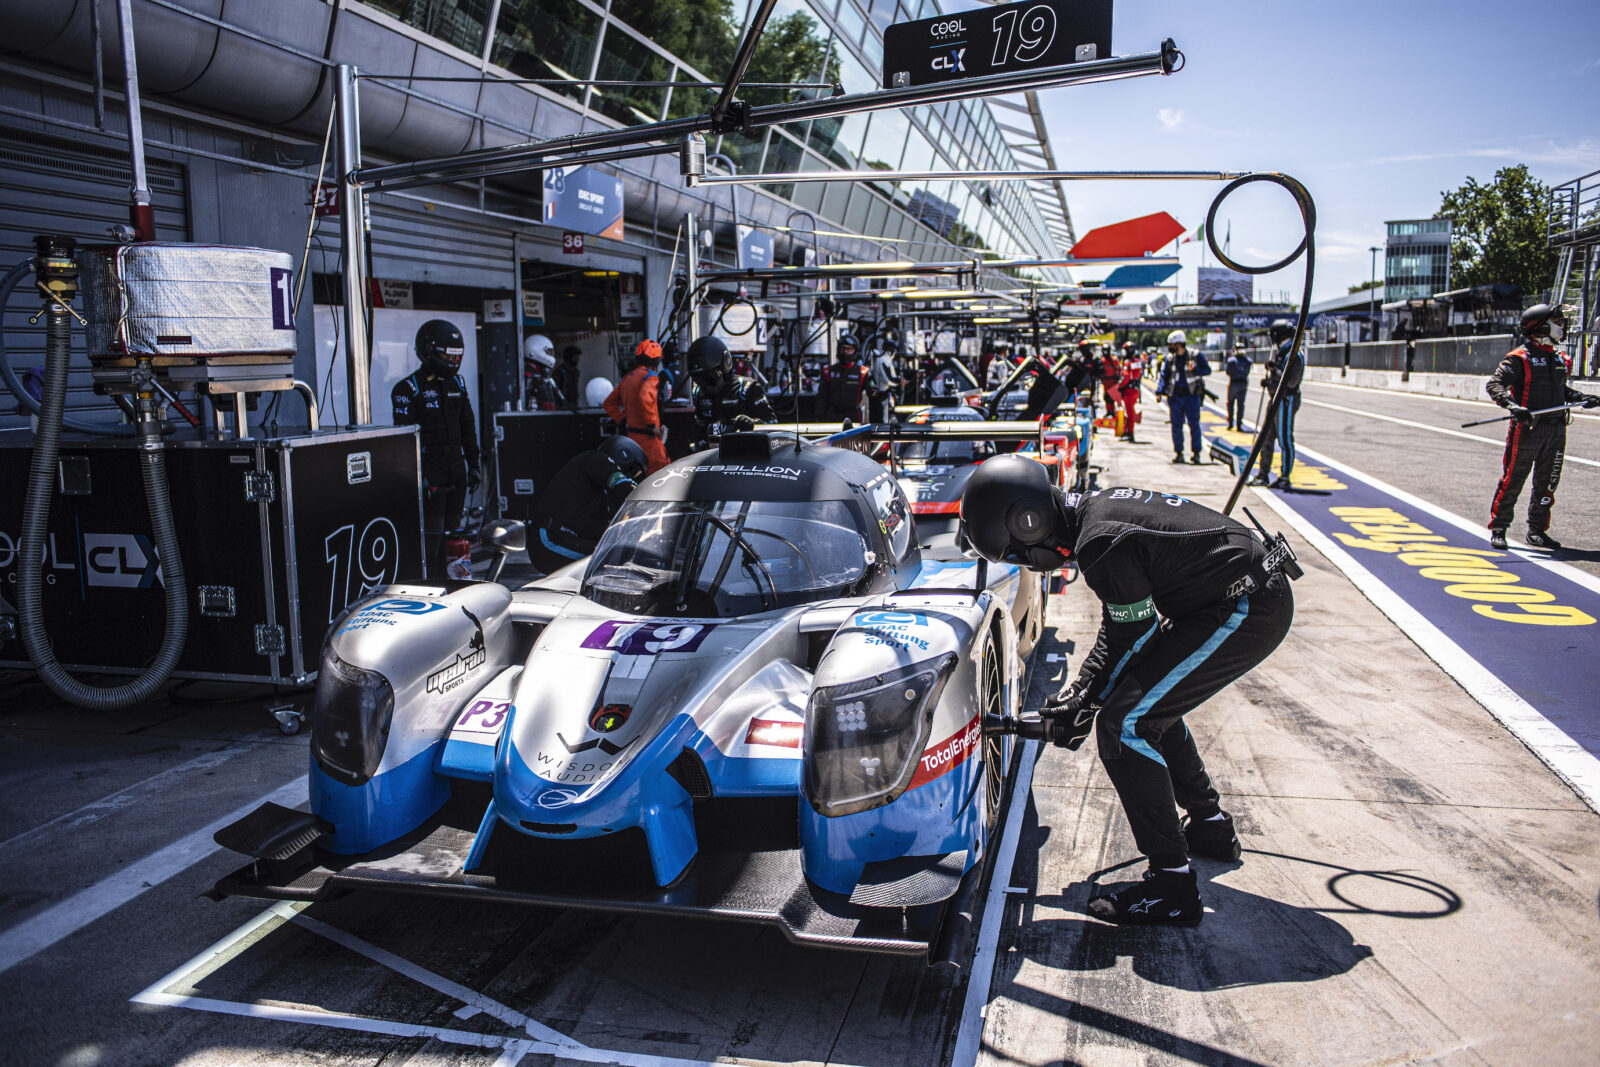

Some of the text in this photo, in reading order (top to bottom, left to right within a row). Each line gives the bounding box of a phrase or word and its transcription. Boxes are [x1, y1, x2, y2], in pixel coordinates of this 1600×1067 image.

[931, 19, 967, 36] COOL
[991, 5, 1057, 66] 19
[931, 48, 966, 73] CLX
[313, 186, 338, 207] 37
[563, 234, 583, 248] 36
[277, 272, 293, 327] 1
[681, 465, 801, 477] REBELLION
[723, 471, 798, 481] TIMEPIECES
[1550, 450, 1564, 483] SPORT
[325, 517, 399, 624] 19
[1328, 506, 1597, 626] GOODYEAR
[343, 617, 399, 626] Stiftung
[1137, 608, 1151, 618] PIT
[606, 623, 704, 653] 19
[865, 624, 909, 632] ADAC
[864, 630, 931, 651] Stiftung
[864, 637, 910, 653] Sport
[445, 678, 464, 692] SPORTS
[458, 700, 511, 728] P3
